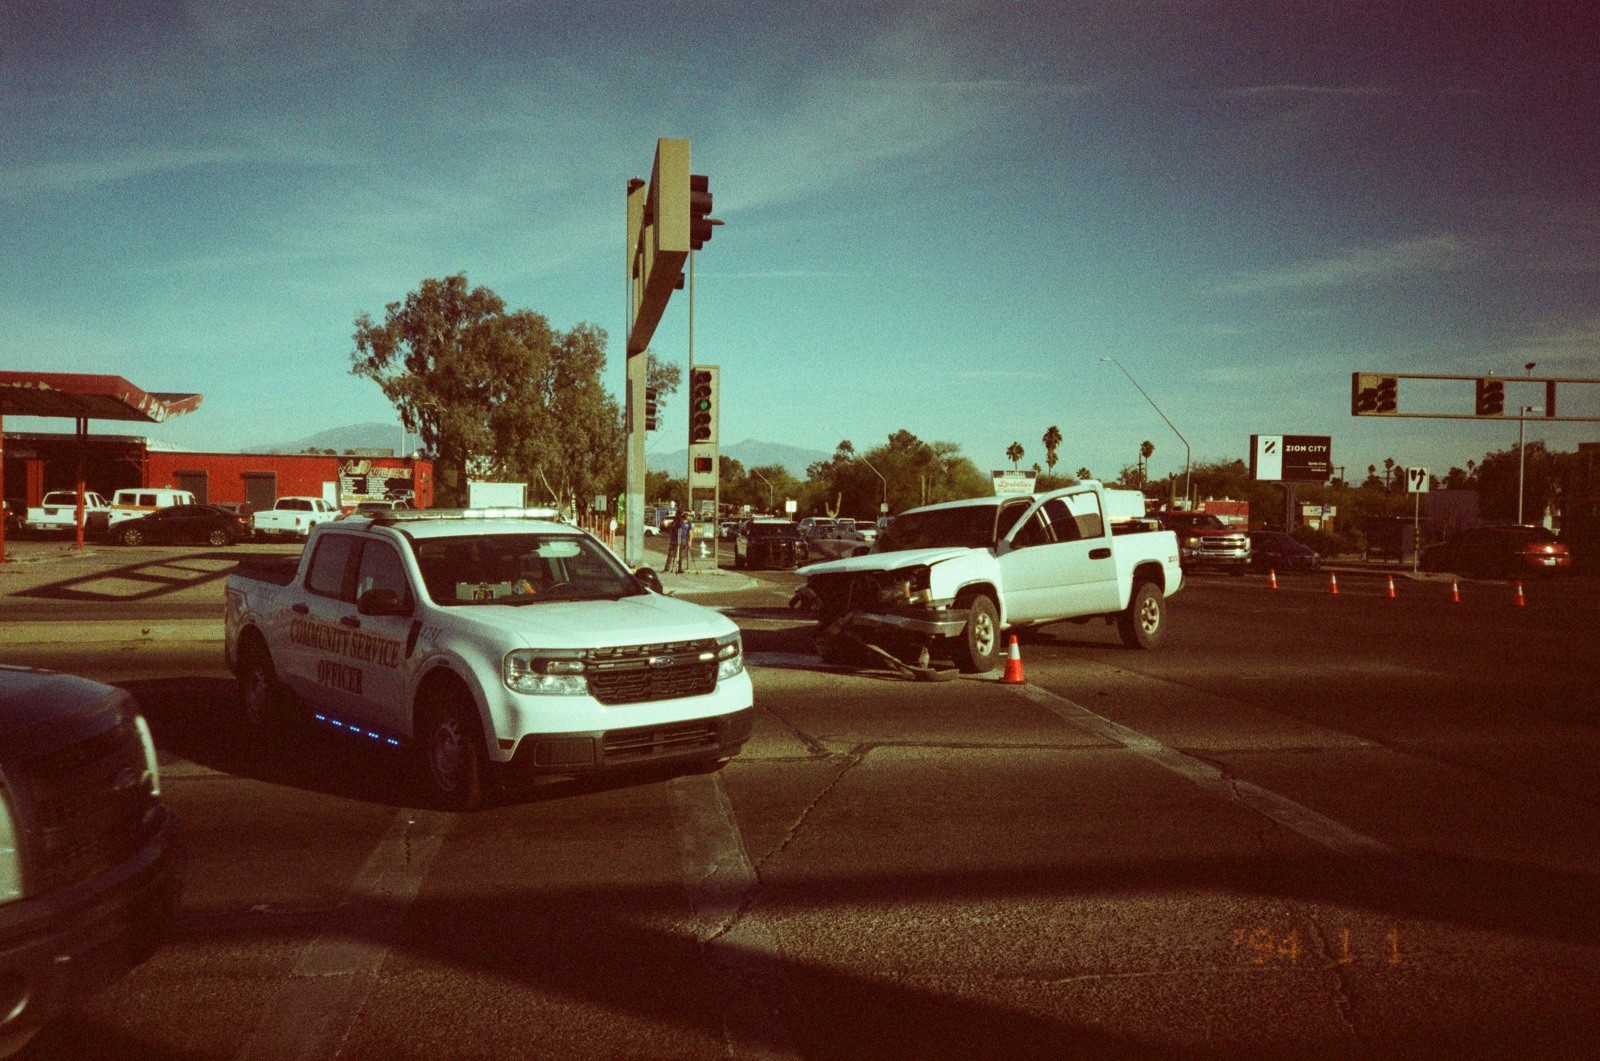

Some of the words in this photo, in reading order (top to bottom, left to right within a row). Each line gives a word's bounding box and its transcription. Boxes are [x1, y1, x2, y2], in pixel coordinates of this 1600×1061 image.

[290, 618, 351, 656] COMMUNITY
[351, 632, 400, 668] SERVICE
[318, 659, 363, 695] OFFICER
